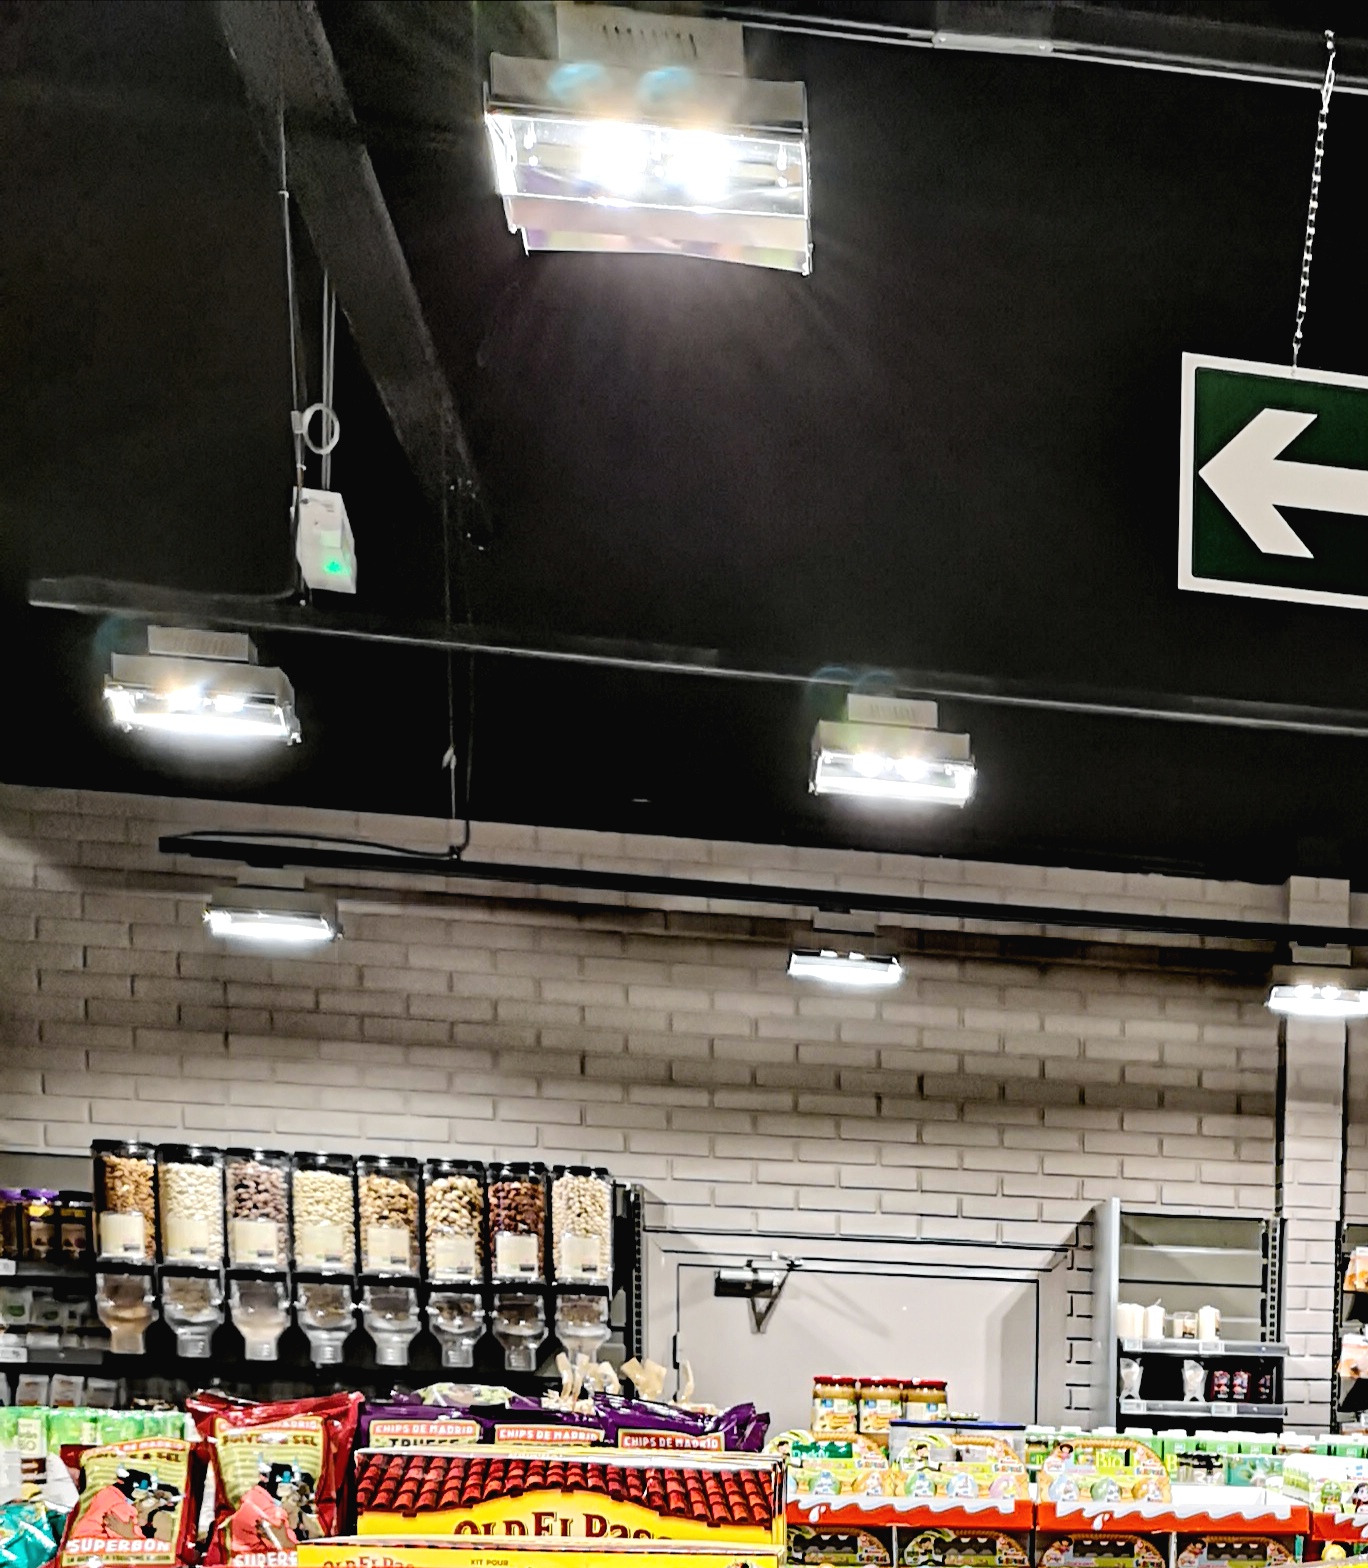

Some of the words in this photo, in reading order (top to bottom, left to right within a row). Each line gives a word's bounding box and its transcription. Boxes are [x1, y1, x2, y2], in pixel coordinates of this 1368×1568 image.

[412, 1424, 426, 1434] DE
[430, 1424, 474, 1435] MADRID
[500, 1428, 534, 1440] CHIPS
[536, 1429, 551, 1440] DE
[554, 1429, 598, 1441] MADRID
[623, 1437, 657, 1448] CHIPS
[659, 1437, 673, 1448] DE
[675, 1436, 719, 1449] MADRID
[67, 1536, 171, 1554] SUPERBON
